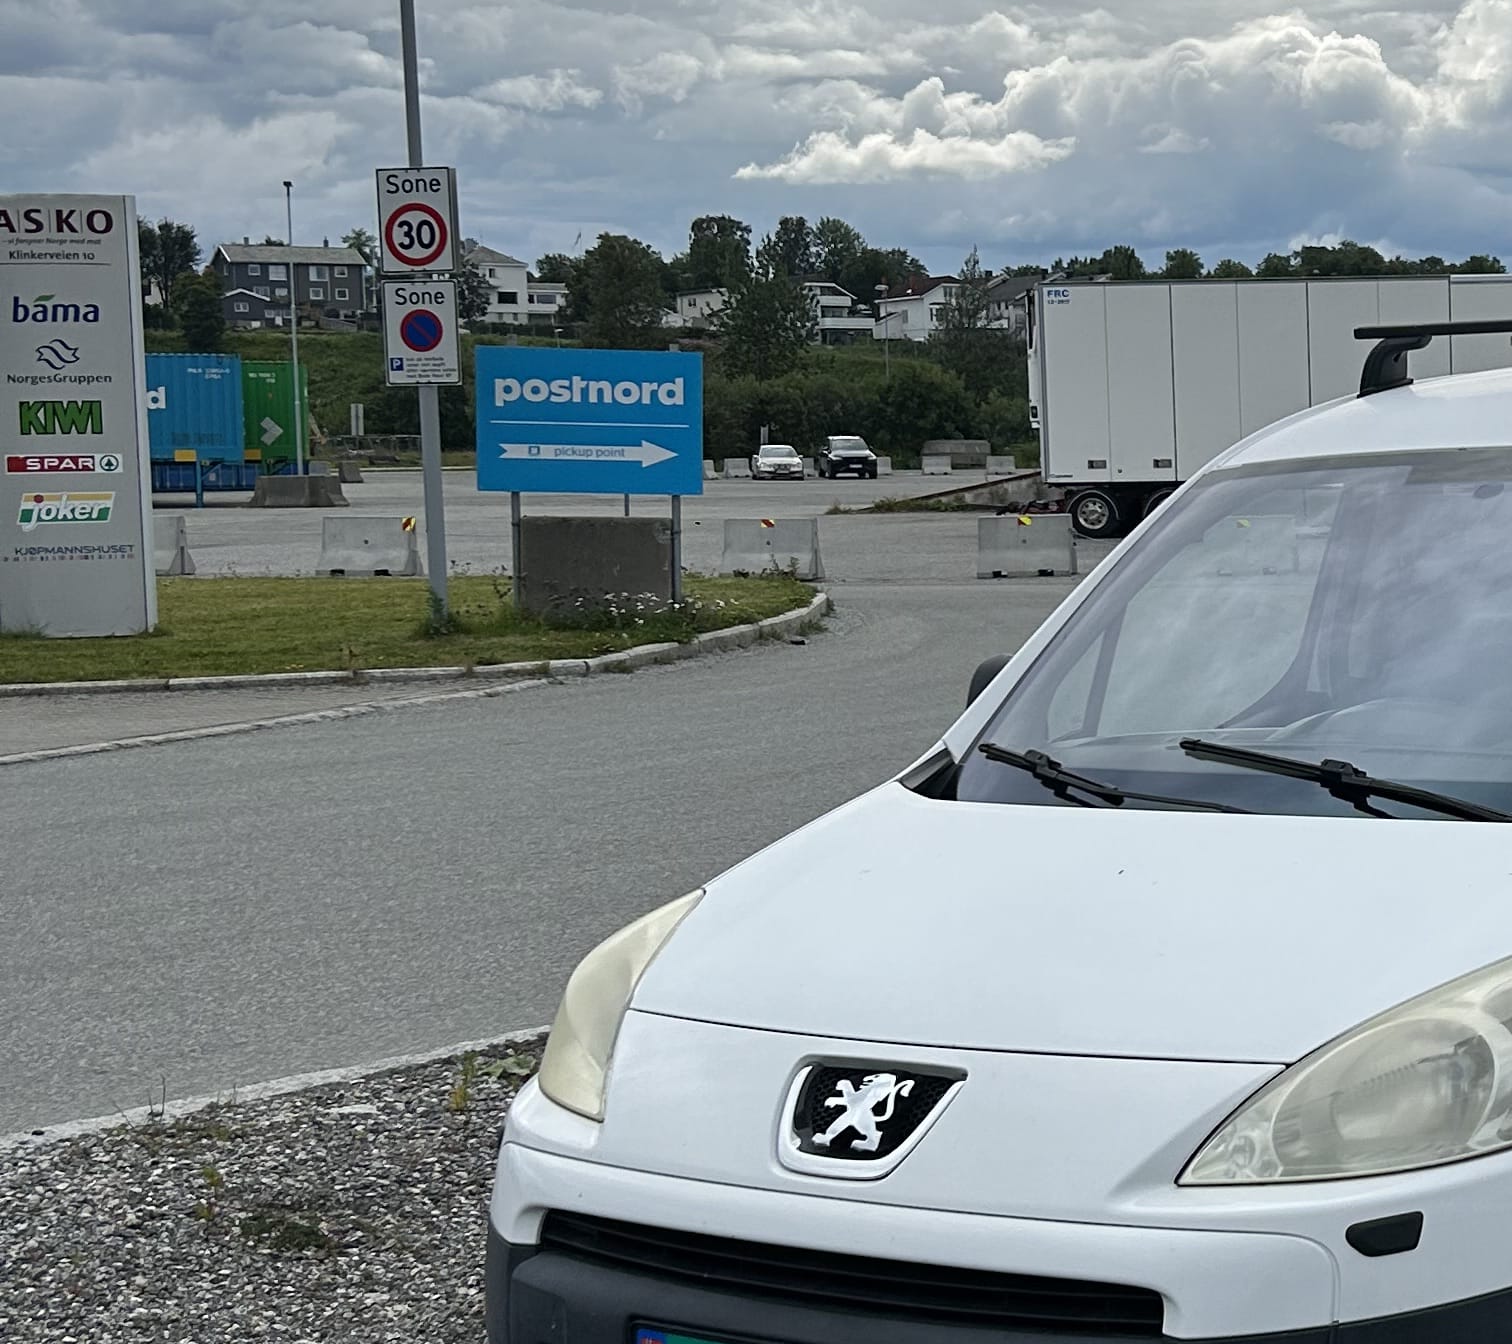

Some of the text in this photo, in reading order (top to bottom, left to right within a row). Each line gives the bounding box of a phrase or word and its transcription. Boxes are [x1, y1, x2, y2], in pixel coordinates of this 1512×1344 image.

[386, 174, 441, 194] Sone
[0, 208, 113, 234] ASKO
[397, 219, 436, 250] 30
[9, 250, 96, 260] Klinkerveien 10
[395, 287, 445, 305] Sone
[1047, 289, 1070, 298] FRC
[7, 373, 112, 385] NorgesGruppen
[494, 375, 684, 407] postnord
[19, 400, 103, 435] KIWI
[554, 446, 625, 458] pickup point
[26, 458, 94, 470] SPAR
[22, 493, 108, 532] joker
